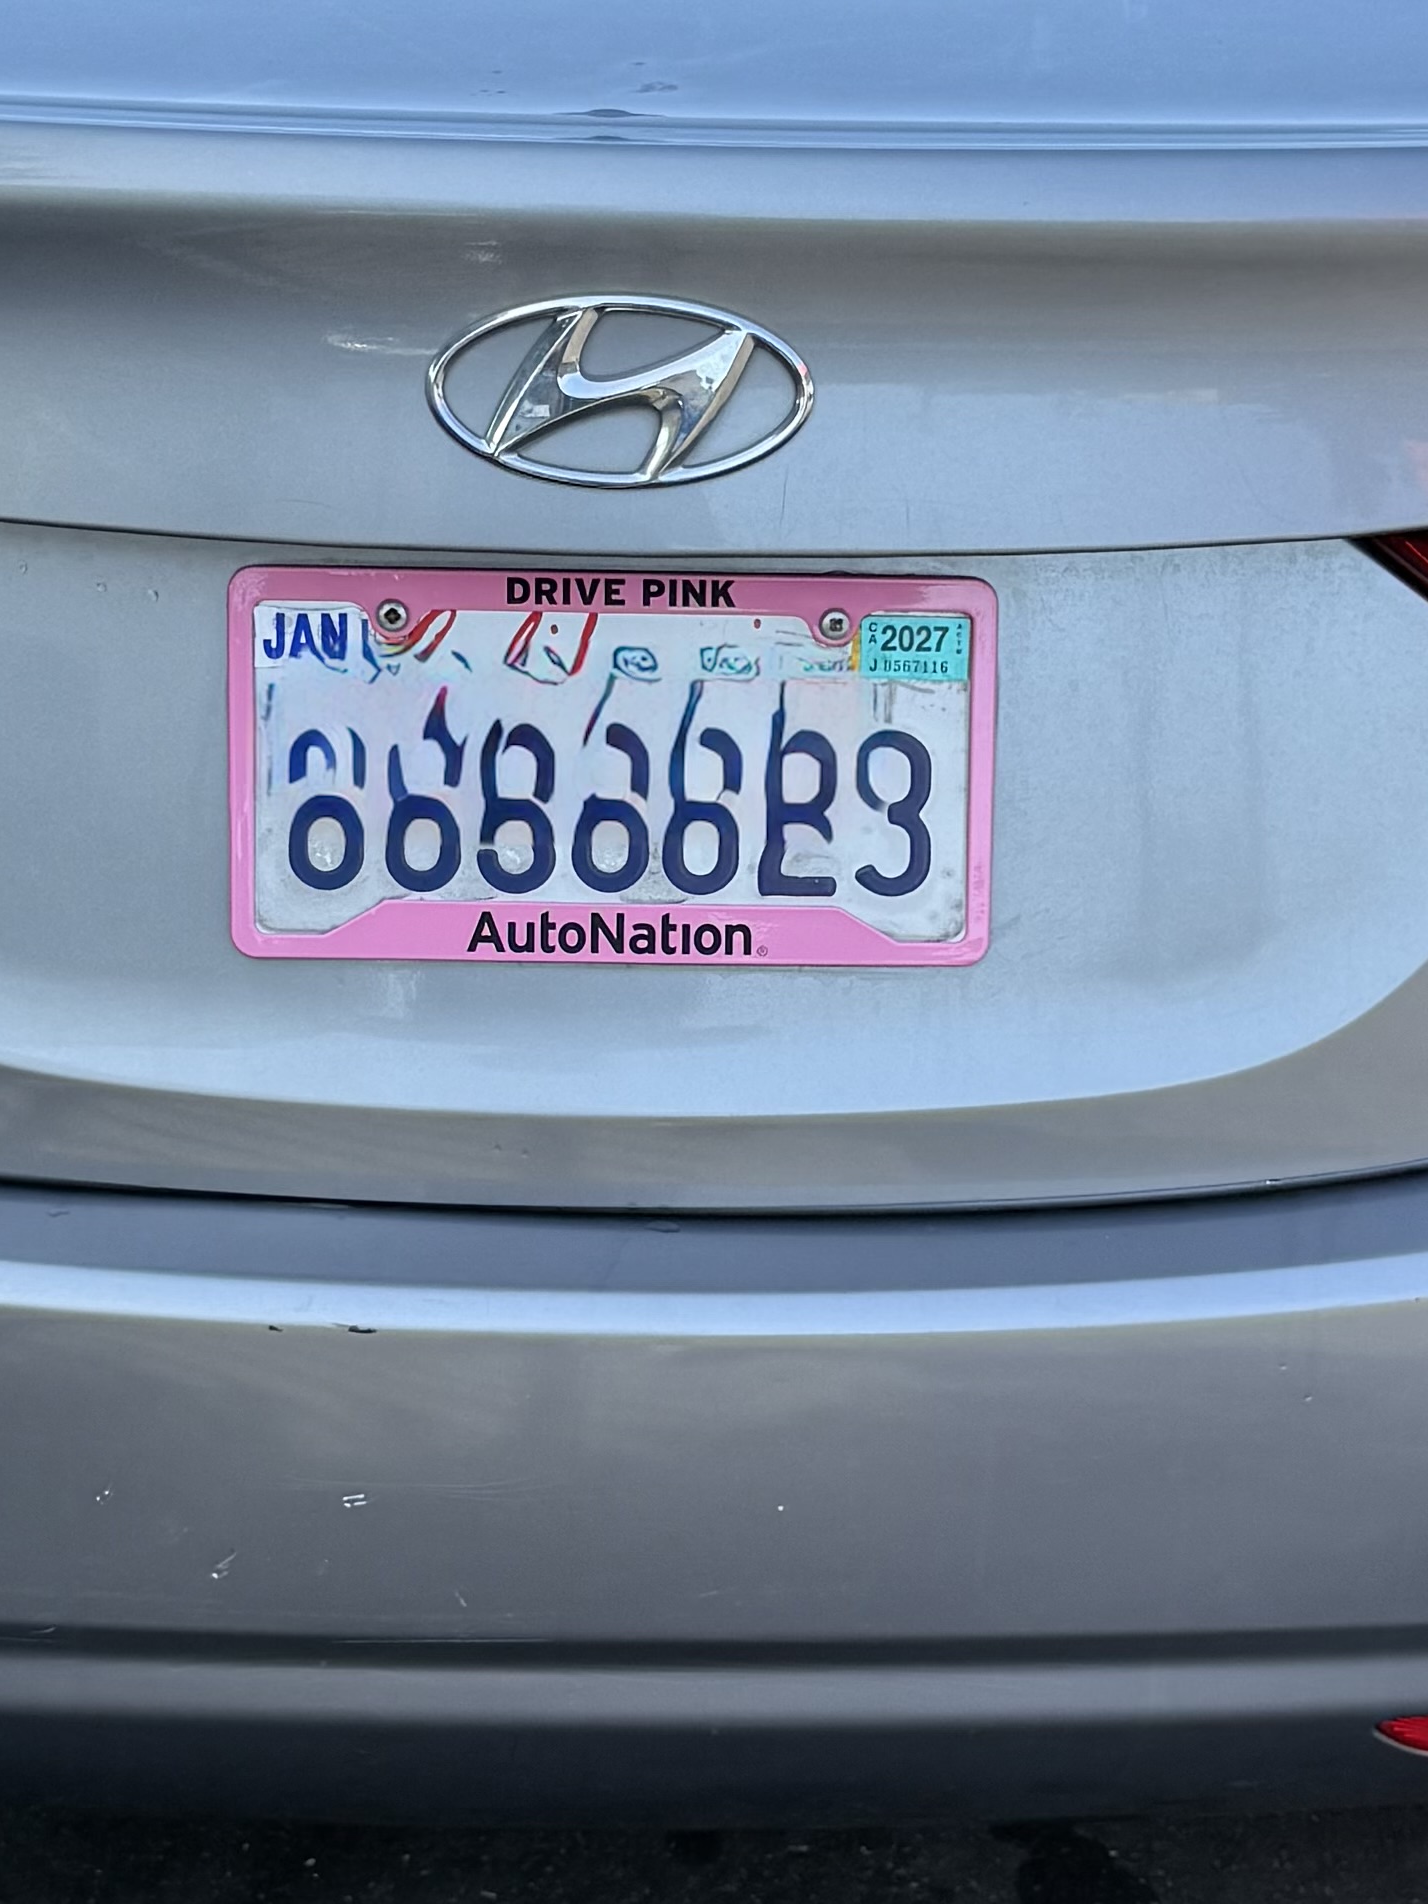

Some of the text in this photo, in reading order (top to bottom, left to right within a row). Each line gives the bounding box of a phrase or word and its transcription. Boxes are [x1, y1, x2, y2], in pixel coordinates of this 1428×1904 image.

[506, 576, 737, 608] DRIVE PINK
[262, 612, 349, 661] JAN
[880, 624, 950, 653] 2027
[466, 910, 753, 956] AutoNation
